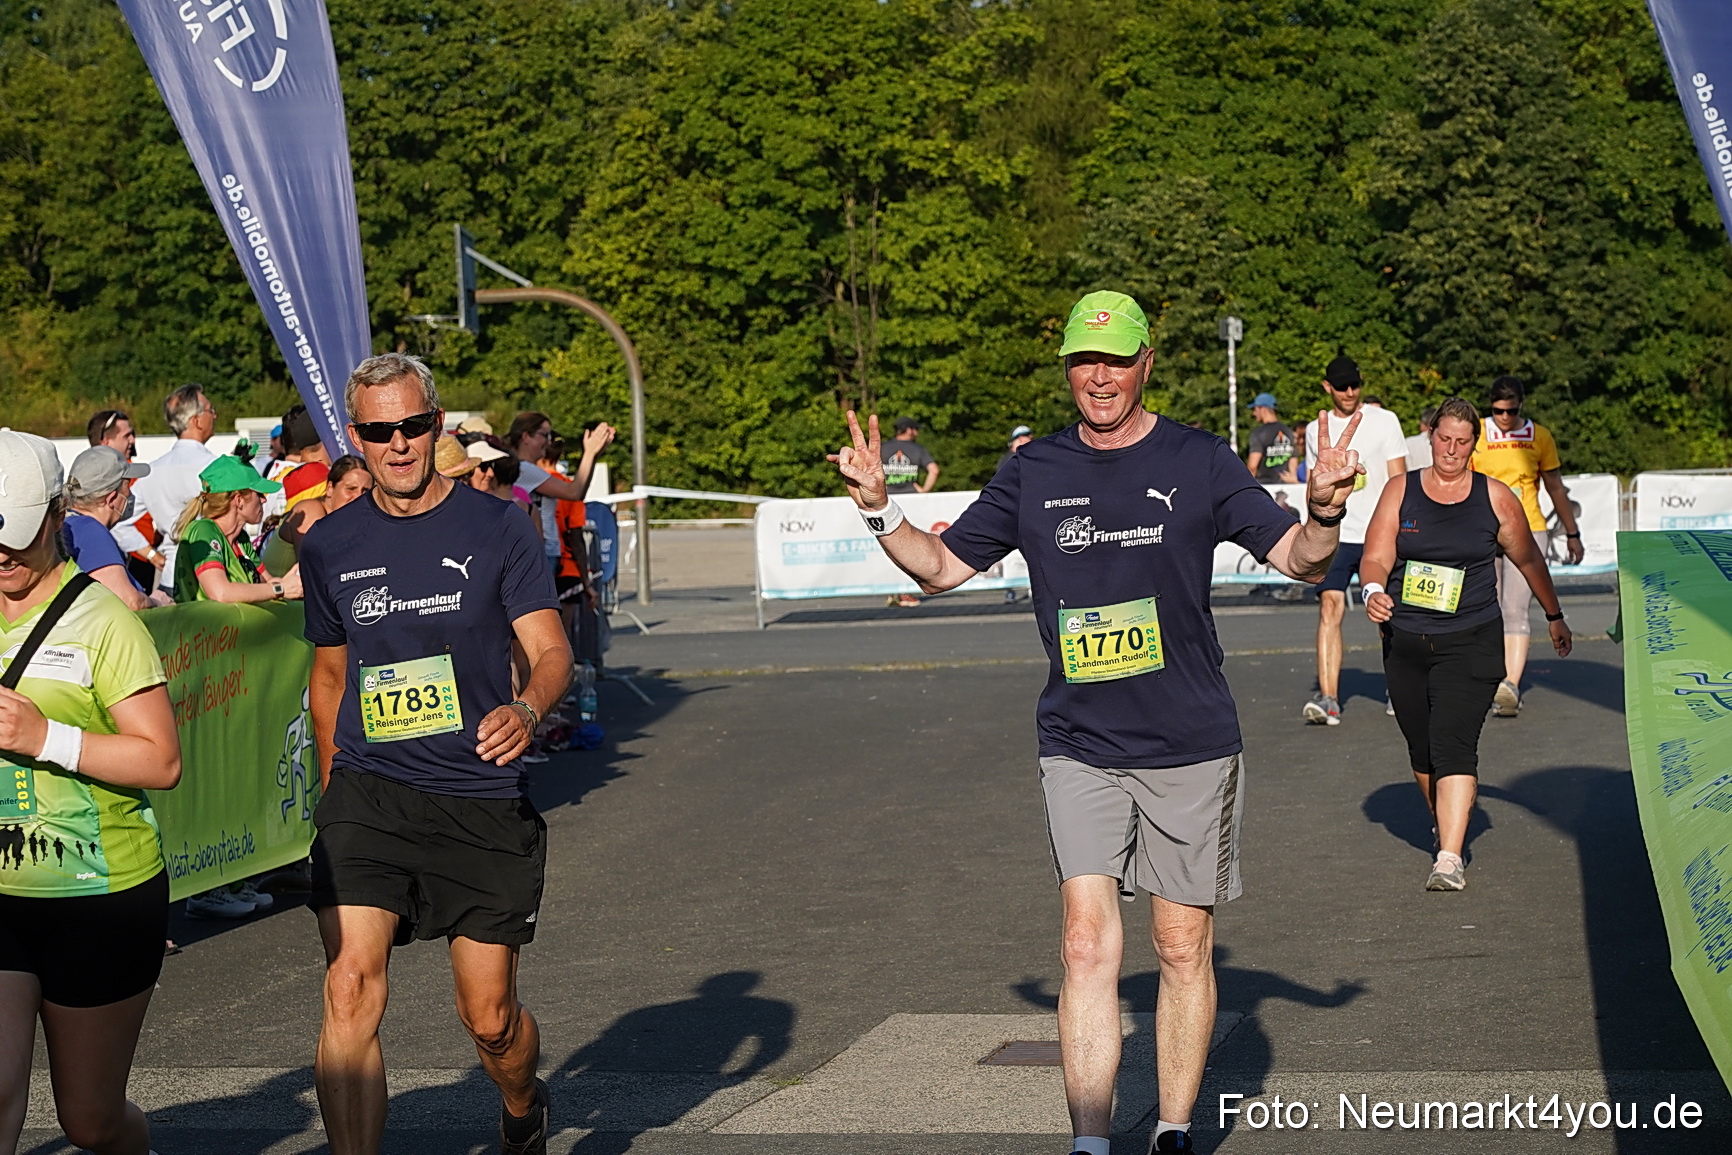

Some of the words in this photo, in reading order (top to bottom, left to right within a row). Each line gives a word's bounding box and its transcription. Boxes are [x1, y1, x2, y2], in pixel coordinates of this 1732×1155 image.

[1487, 443, 1508, 451] MAX
[1051, 497, 1091, 509] PFLEIDERER
[1660, 496, 1696, 508] NOW
[780, 519, 815, 534] NOW
[1093, 524, 1164, 543] Firmenlauf
[1121, 536, 1163, 548] neumarkt
[346, 567, 387, 581] PFLEIDERER
[1416, 578, 1445, 596] 491
[1450, 587, 1459, 606] 2022
[390, 591, 462, 613] Firmenlauf
[419, 603, 461, 616] neumarkt
[194, 625, 239, 666] Firmen
[1077, 627, 1144, 658] 1770
[1146, 627, 1158, 660] 2022
[1066, 639, 1078, 674] WALK
[1077, 656, 1120, 669] Landmann
[1122, 650, 1149, 662] Rudolf
[203, 654, 248, 717] länger!
[373, 684, 440, 717] 1783
[442, 686, 455, 720] 2022
[363, 697, 375, 732] WALK
[376, 715, 418, 728] Reisinger
[421, 711, 443, 722] Jens
[15, 769, 30, 811] 2022
